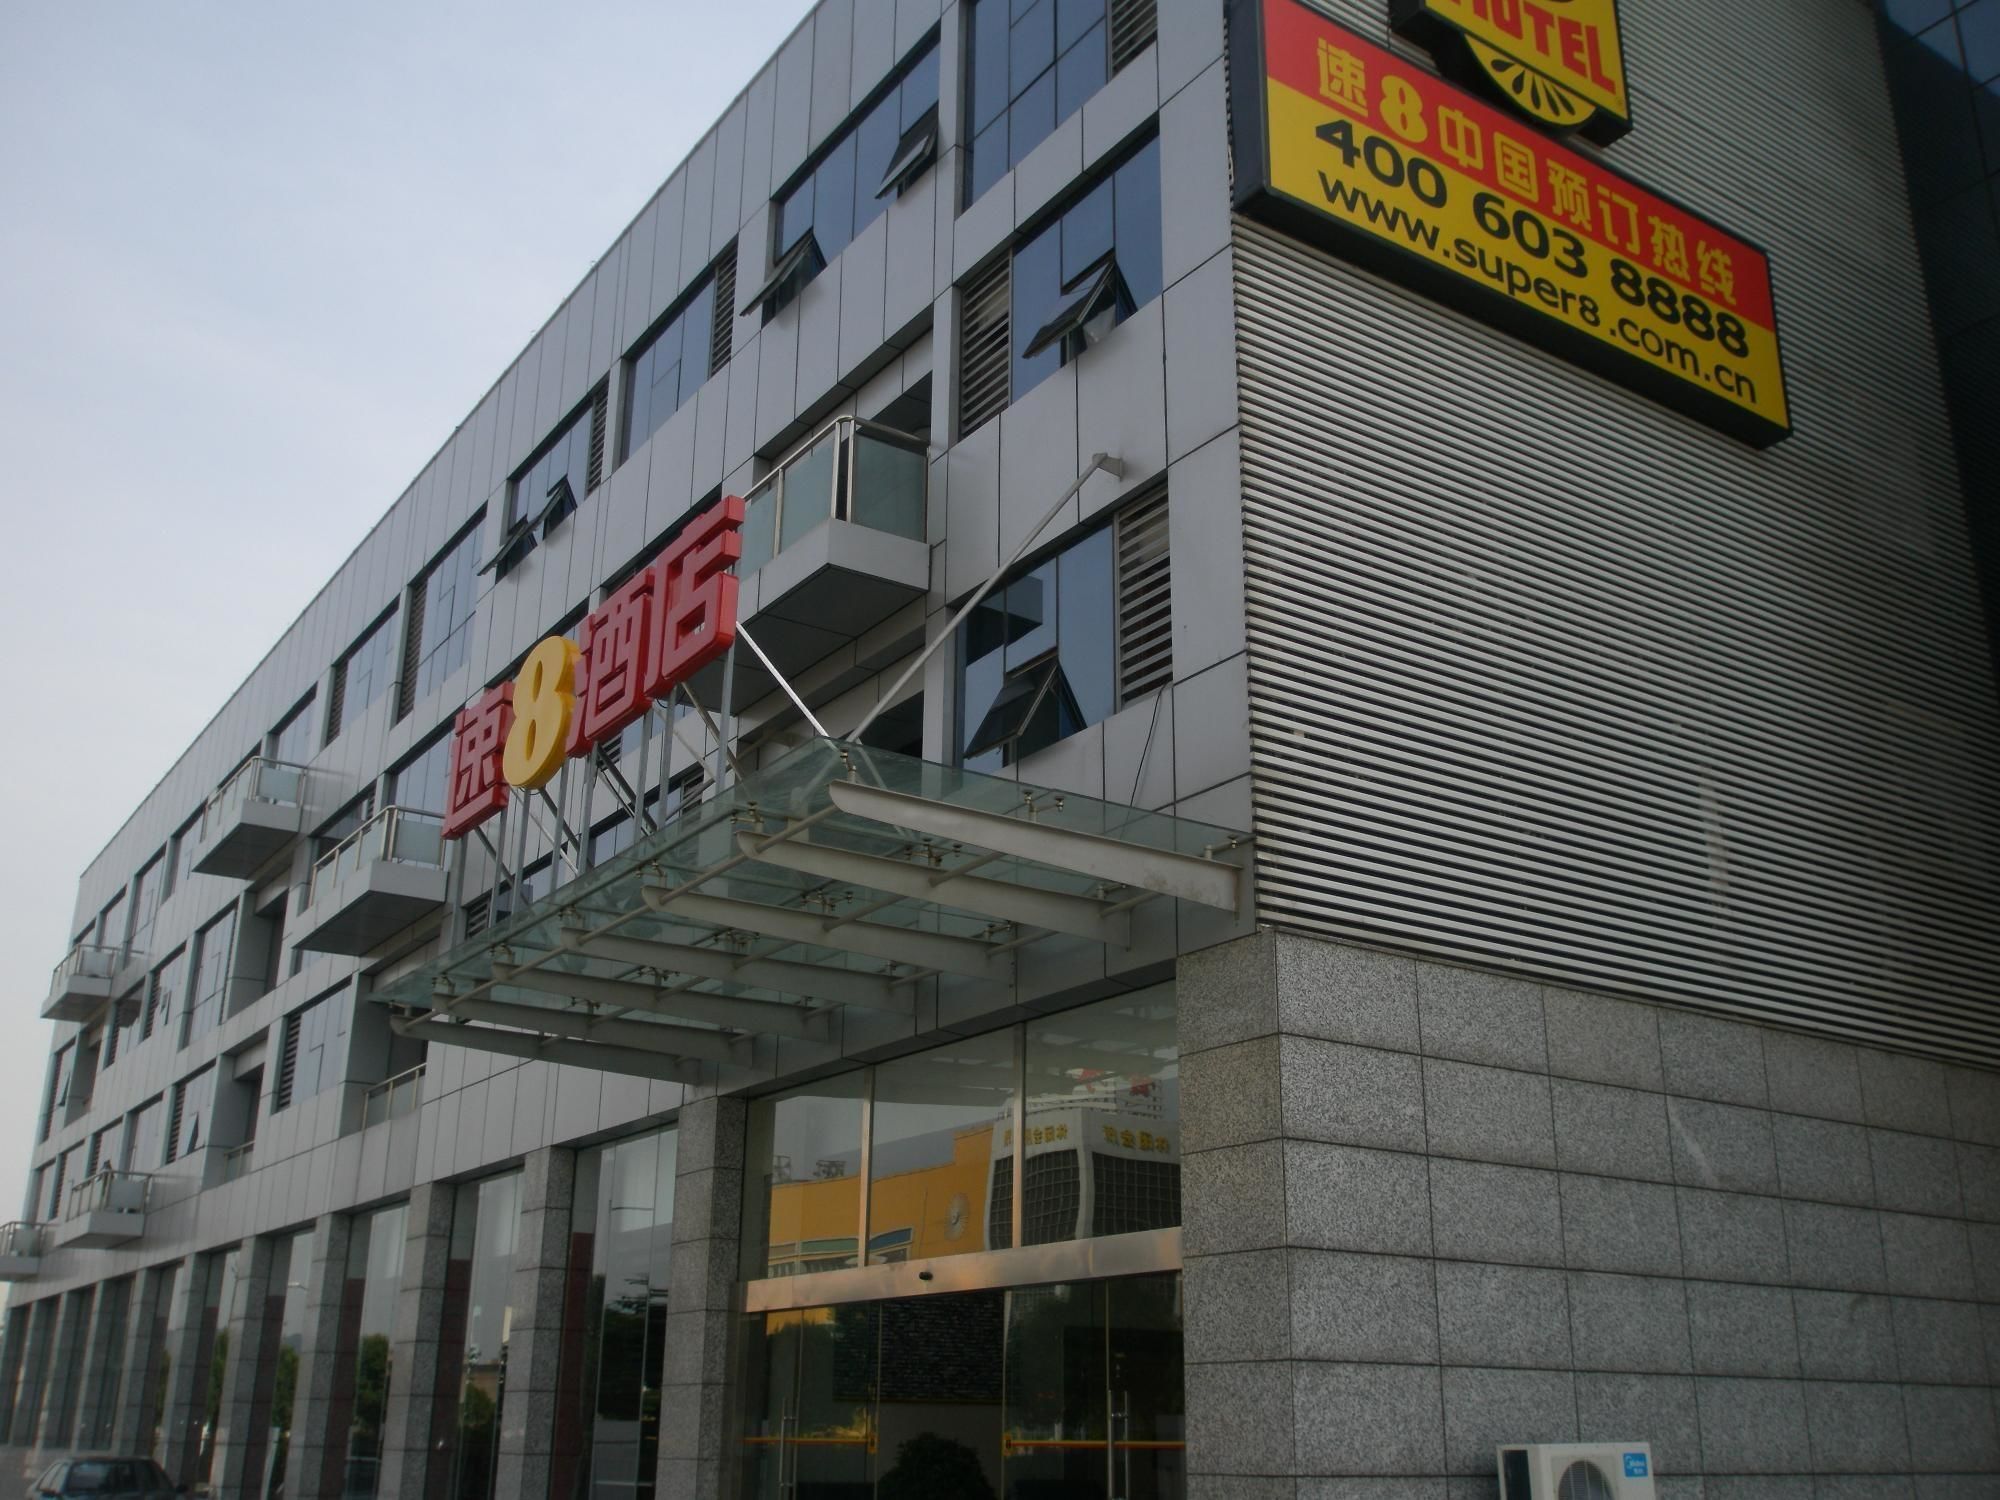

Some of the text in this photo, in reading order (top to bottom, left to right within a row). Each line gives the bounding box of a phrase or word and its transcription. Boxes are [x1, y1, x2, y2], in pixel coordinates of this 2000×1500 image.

[1449, 0, 1616, 95] OTEL
[1315, 118, 1750, 359] 400 603 8888
[1316, 38, 1737, 306] 速8中国预订热线
[1317, 170, 1757, 404] www.super8.com.cn
[441, 495, 745, 839] 速8酒店
